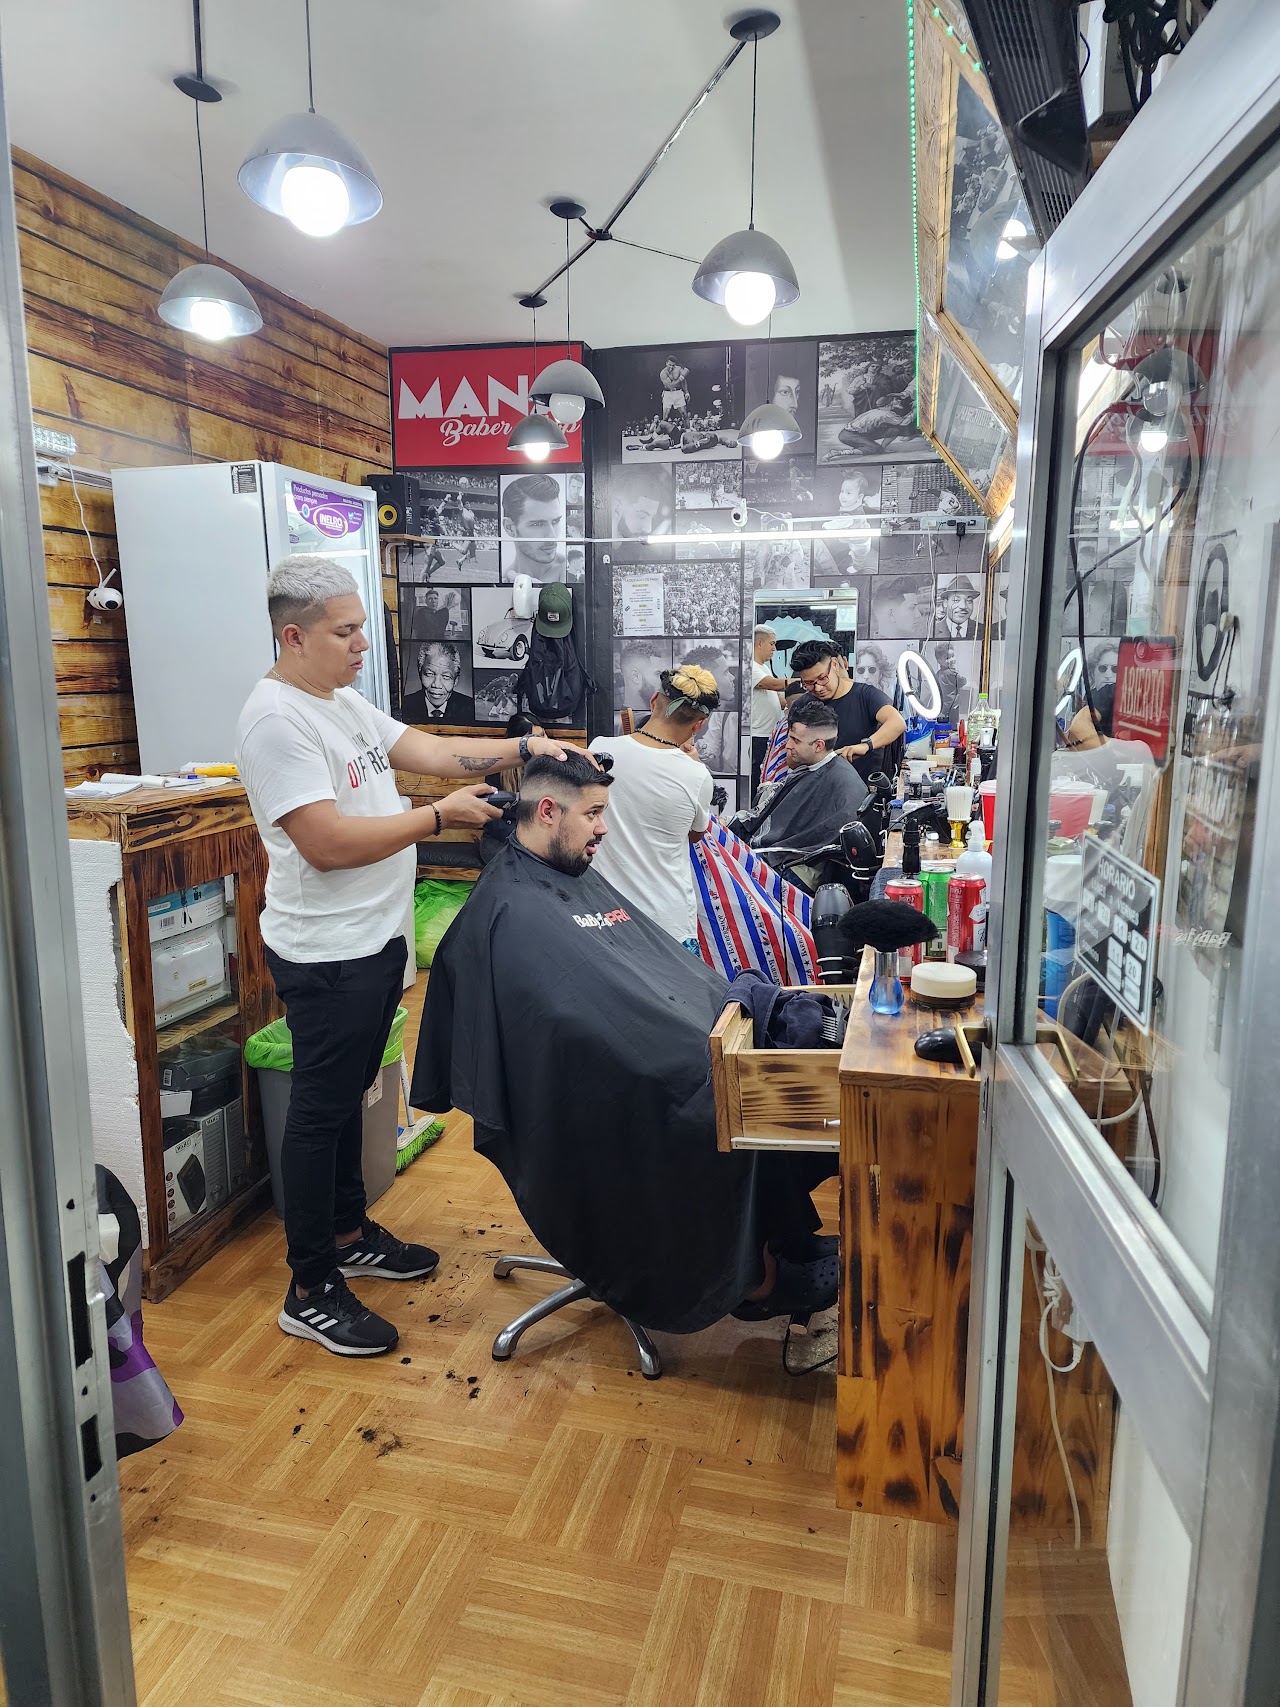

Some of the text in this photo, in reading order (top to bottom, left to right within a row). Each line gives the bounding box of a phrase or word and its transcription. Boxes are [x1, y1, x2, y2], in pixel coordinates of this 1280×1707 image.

[398, 375, 551, 419] MAN
[440, 418, 513, 446] Baber
[1119, 666, 1165, 724] ABIERTO
[1099, 858, 1136, 900] HORARIO
